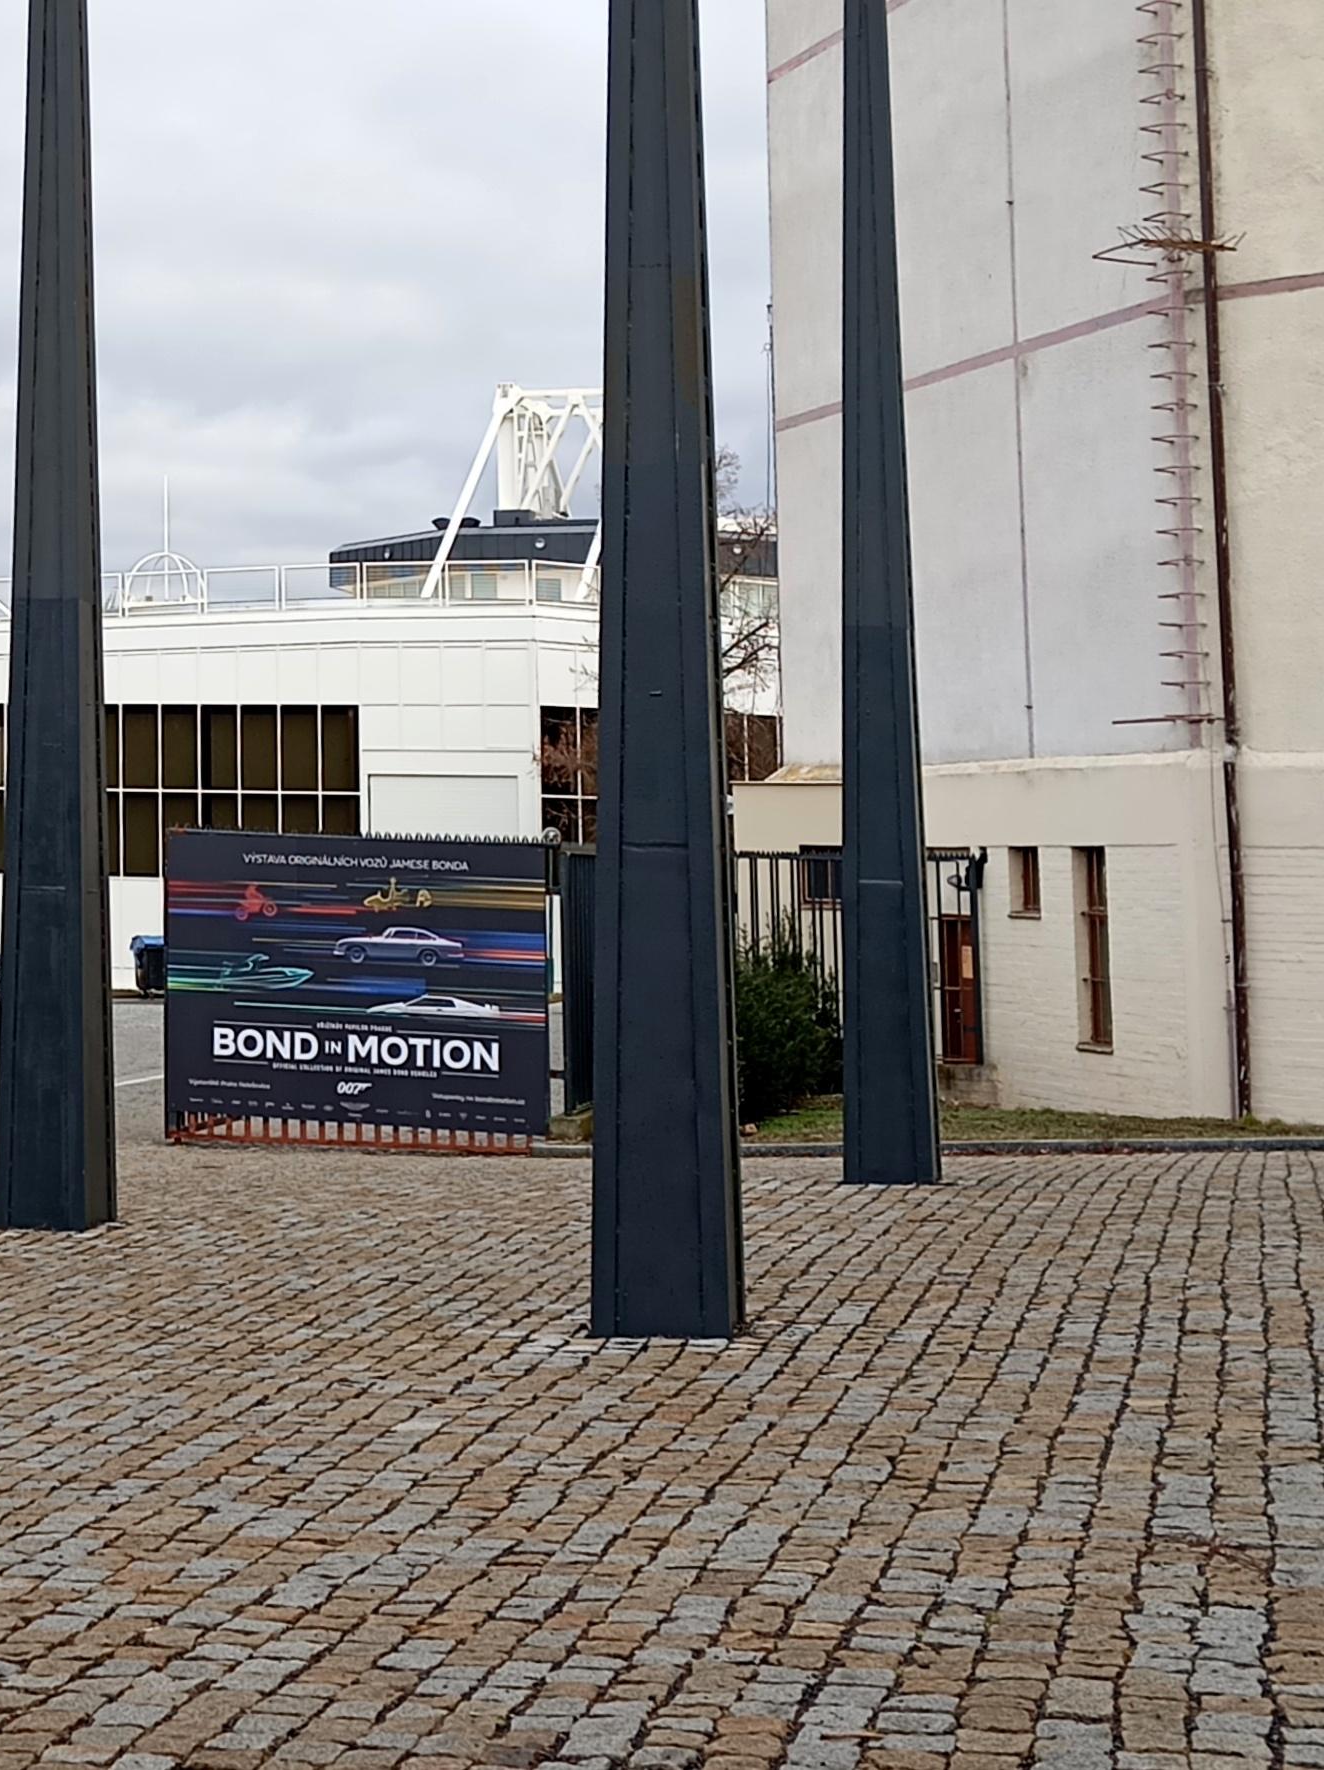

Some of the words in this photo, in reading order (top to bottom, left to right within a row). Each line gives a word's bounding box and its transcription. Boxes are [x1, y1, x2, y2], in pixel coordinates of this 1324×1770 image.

[242, 851, 286, 865] VÝSTAVA
[389, 858, 430, 870] JAMESE
[431, 859, 469, 871] BONDA
[213, 1026, 319, 1061] BOND
[324, 1040, 342, 1055] IN
[347, 1033, 500, 1072] MOTION
[337, 1081, 371, 1095] 007
